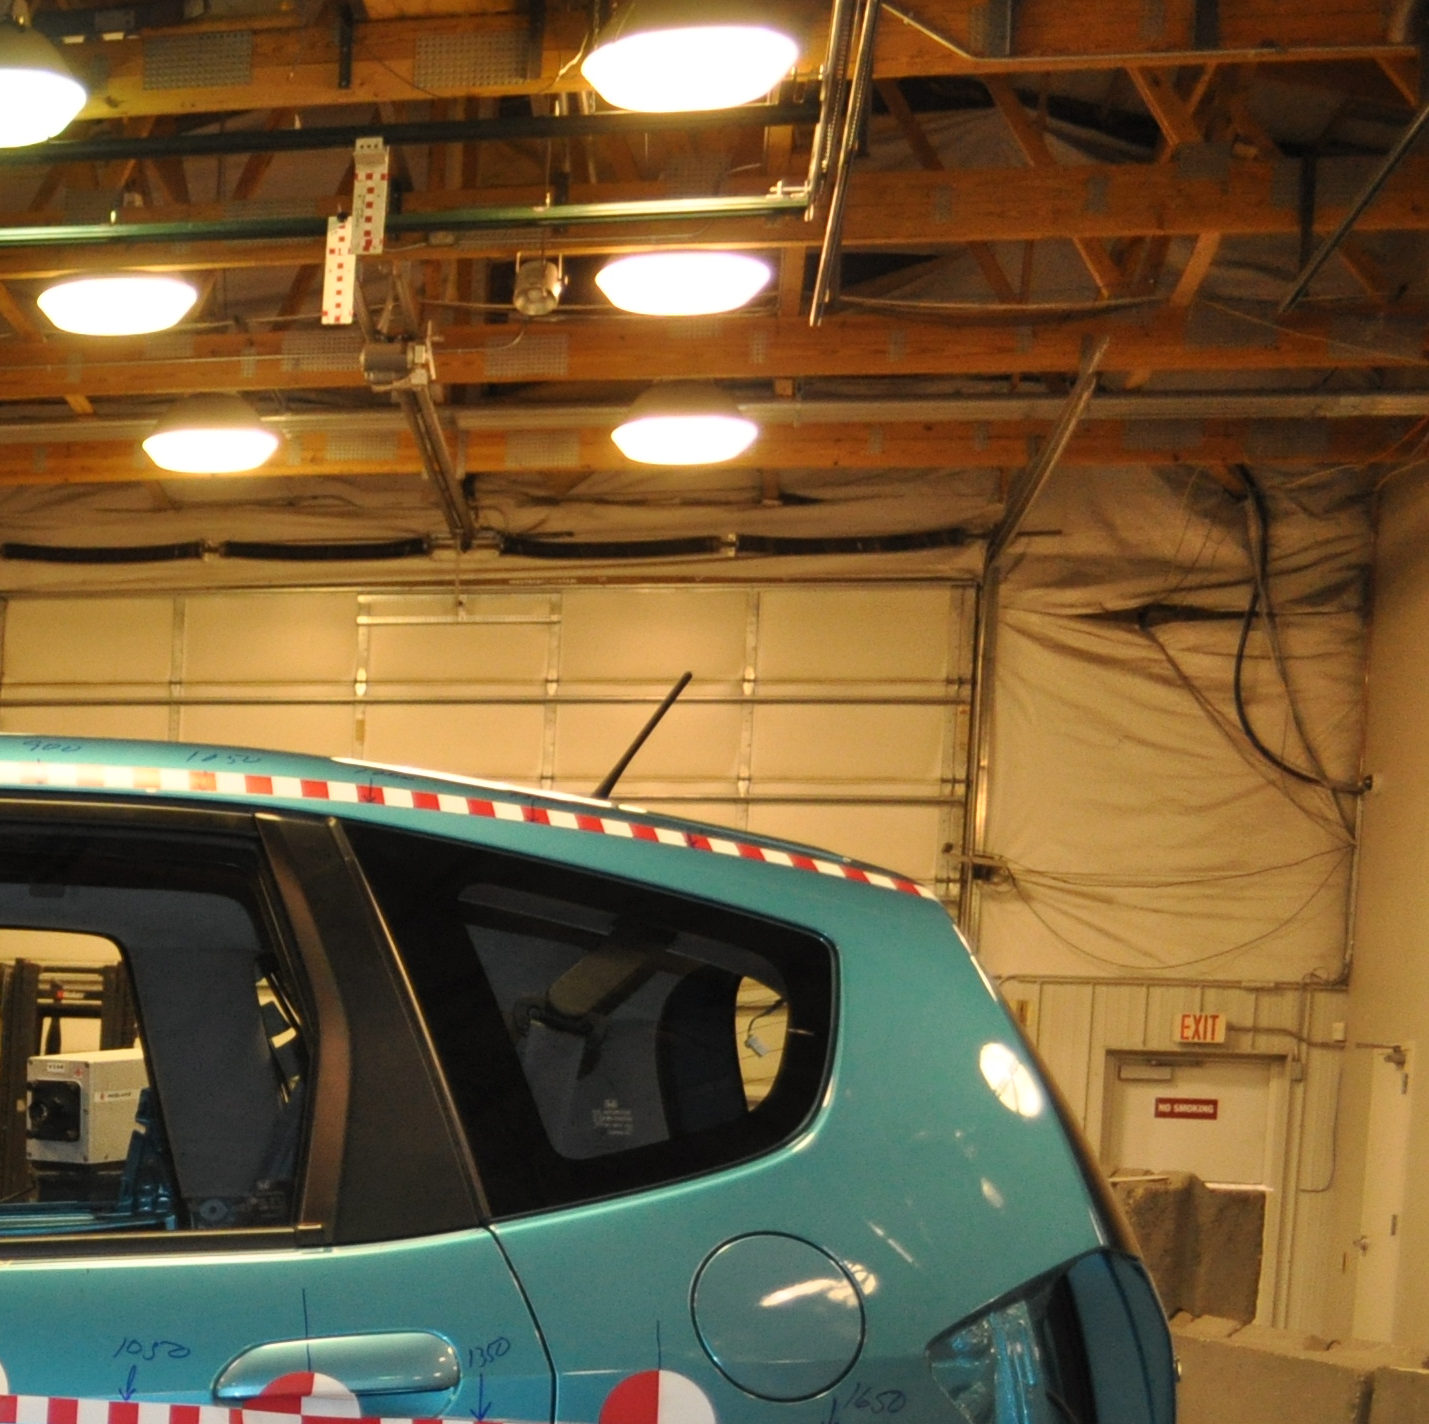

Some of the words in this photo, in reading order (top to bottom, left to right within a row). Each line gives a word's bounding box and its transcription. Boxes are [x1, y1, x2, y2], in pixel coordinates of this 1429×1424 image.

[1180, 1014, 1220, 1041] EXIT
[1157, 1103, 1172, 1113] NO
[1173, 1104, 1215, 1114] SMOKING
[113, 1337, 191, 1361] 1050
[467, 1335, 510, 1367] 1350
[841, 1382, 907, 1414] 1650
